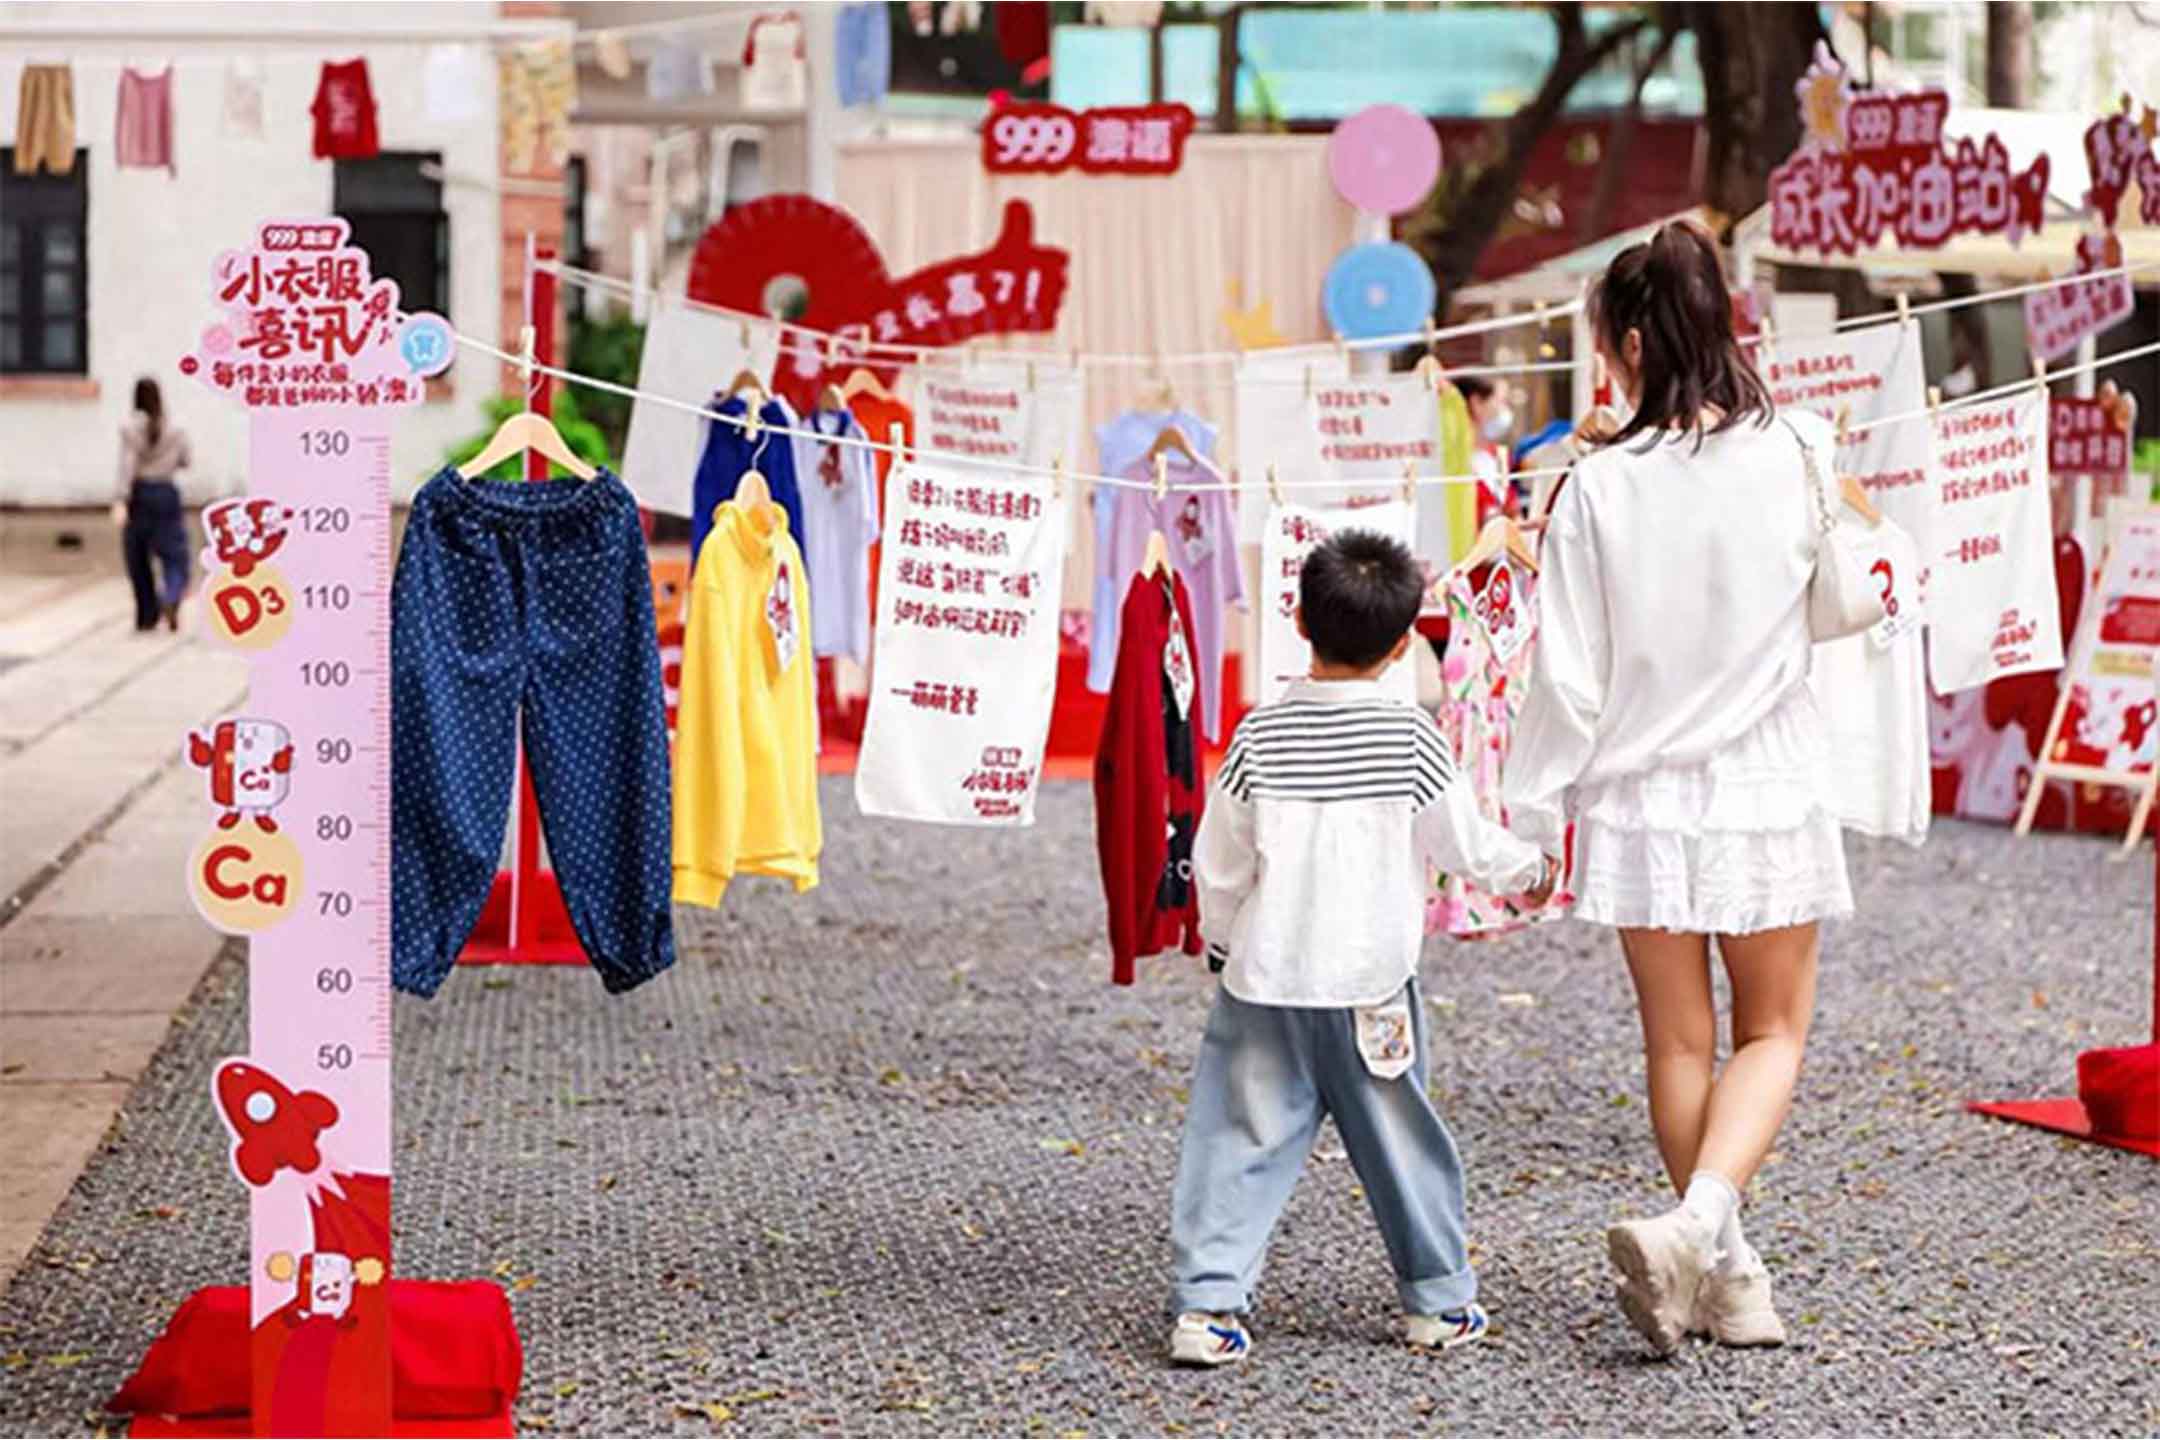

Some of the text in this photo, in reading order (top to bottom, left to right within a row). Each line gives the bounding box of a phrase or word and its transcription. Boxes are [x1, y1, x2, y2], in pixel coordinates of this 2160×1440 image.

[994, 116, 1076, 163] 999
[1775, 143, 2011, 251] 成长加油站
[220, 255, 364, 305] 小衣服
[239, 305, 372, 362] 喜讯
[299, 430, 350, 455] 130
[299, 507, 350, 532] 120
[302, 584, 350, 610] 110
[213, 586, 285, 635] D3
[299, 661, 350, 687] 100
[316, 738, 351, 764] 90
[239, 770, 270, 791] Ca
[316, 815, 352, 840] 80
[203, 845, 287, 906] Ca
[317, 891, 352, 917] 70
[316, 968, 352, 993] 60
[317, 1044, 352, 1070] 50
